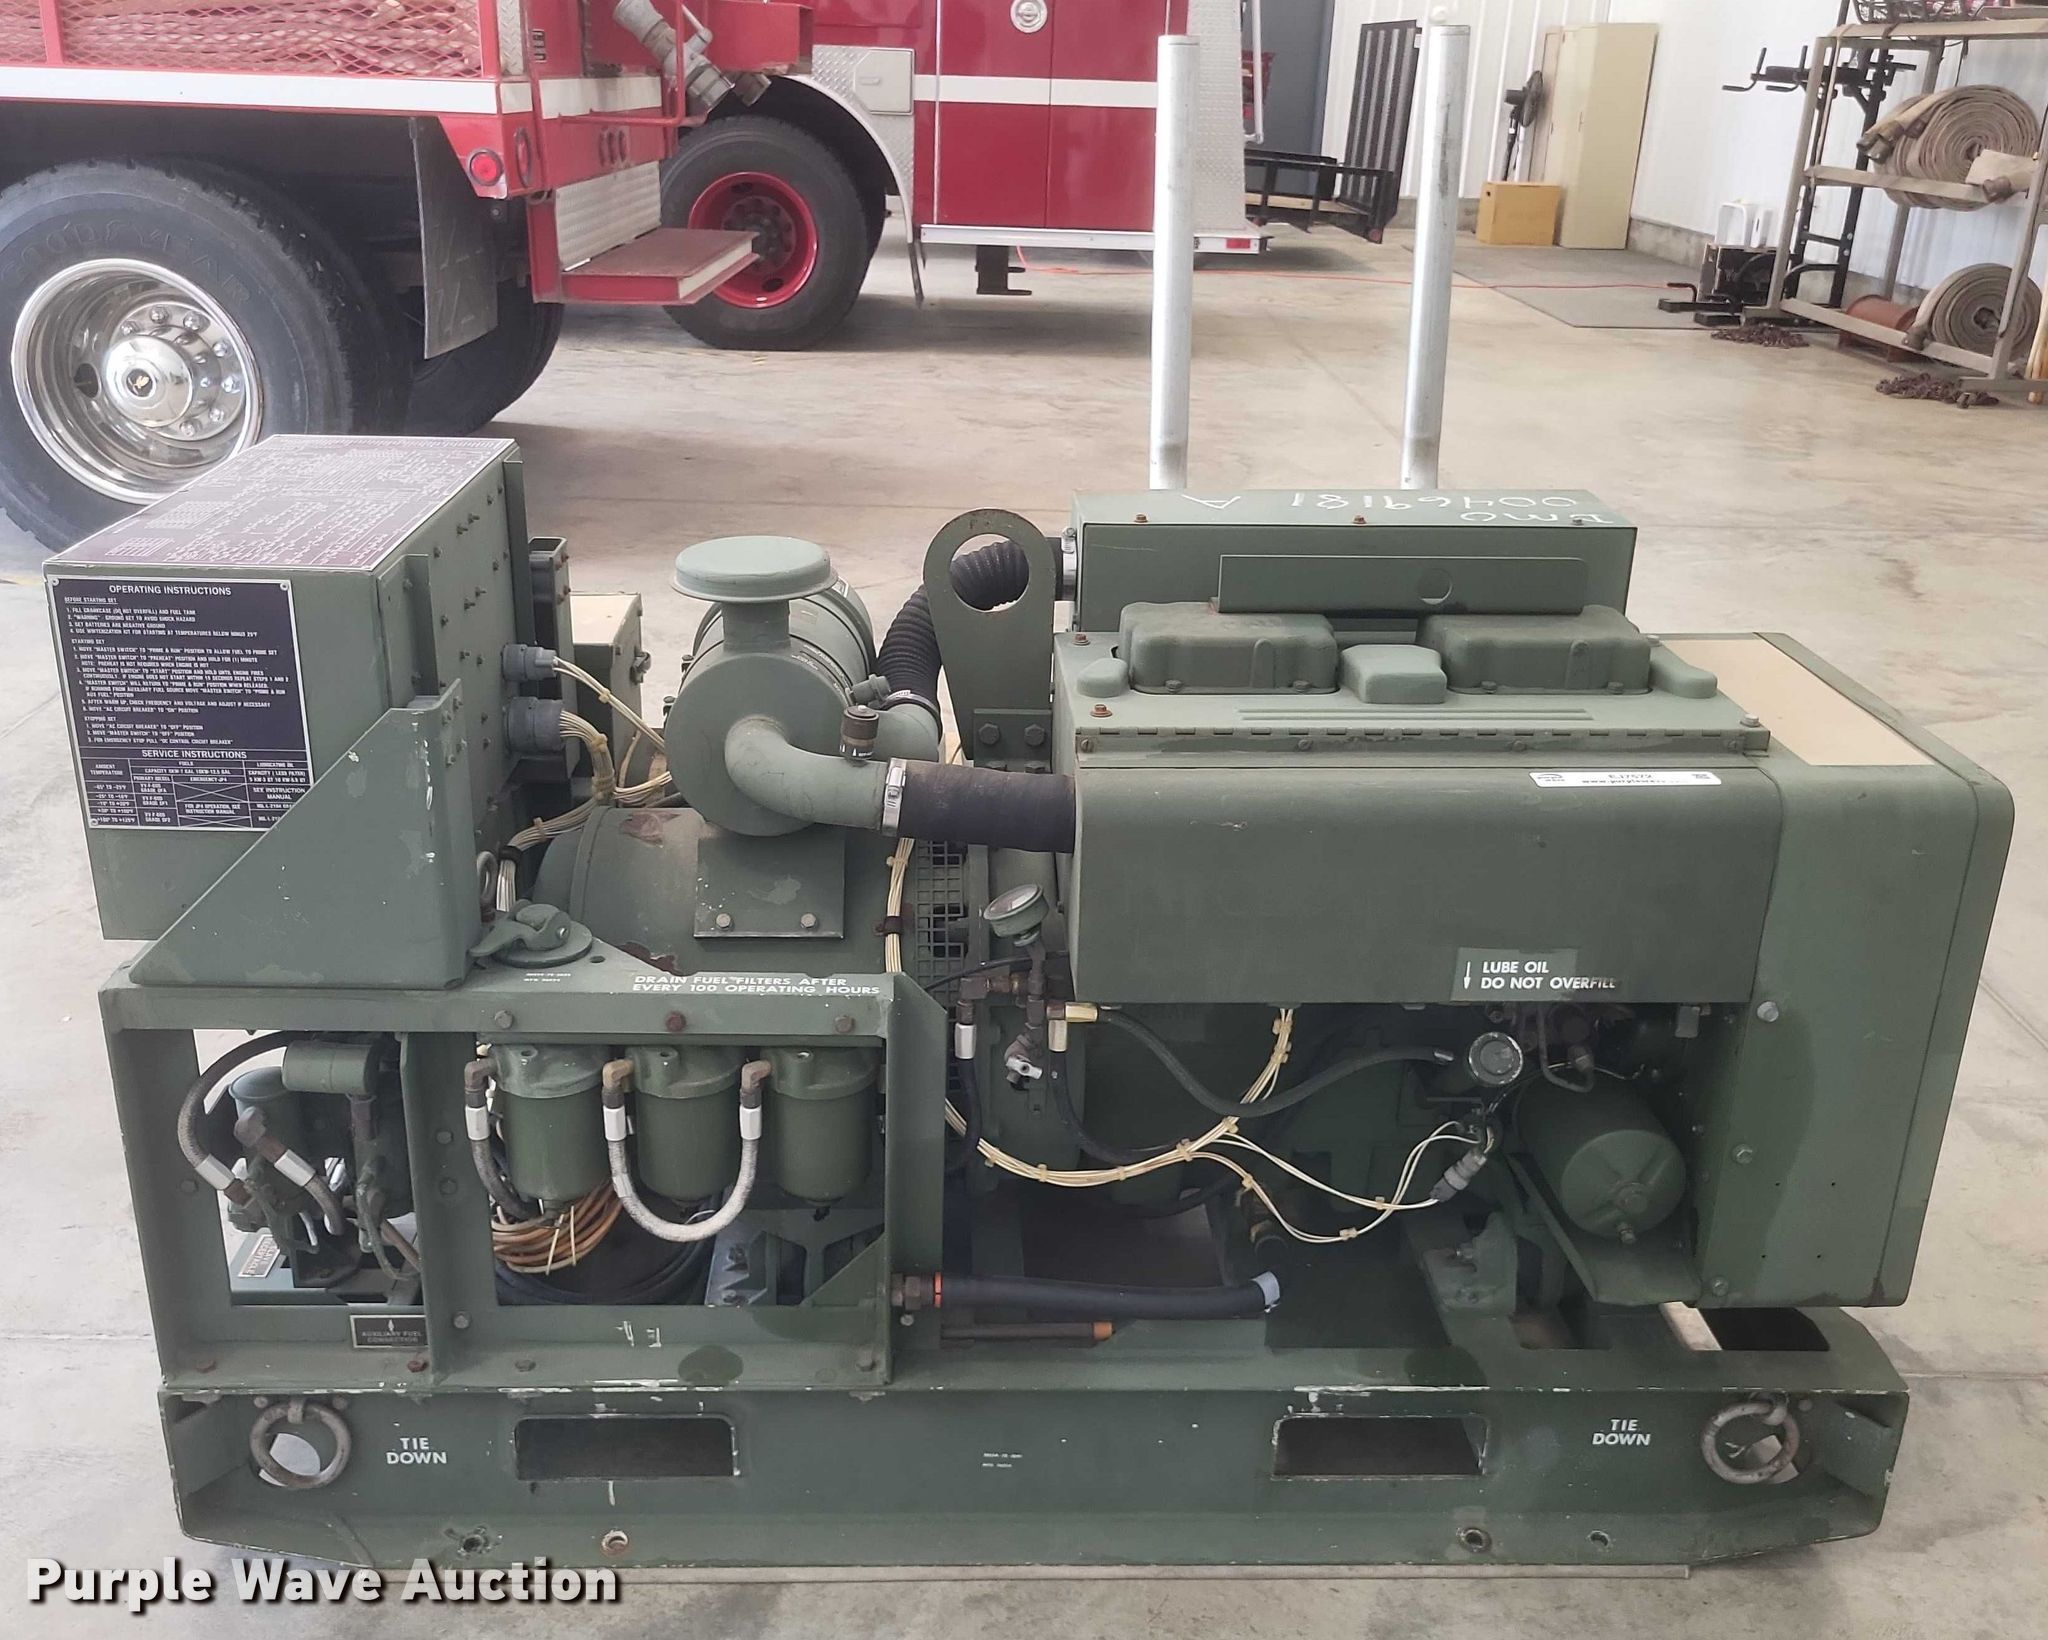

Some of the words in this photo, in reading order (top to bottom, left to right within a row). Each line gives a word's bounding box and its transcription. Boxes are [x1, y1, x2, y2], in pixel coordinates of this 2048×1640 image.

[1181, 494, 1241, 509] A
[164, 586, 232, 595] INSTRUCTIONS
[182, 751, 248, 759] INSTRUCTIONS
[1482, 961, 1519, 974] LUBE
[1523, 961, 1549, 974] OIL
[635, 976, 688, 984] DRAIN
[693, 976, 728, 985] FUEL
[734, 977, 791, 986] FILTERS
[798, 977, 848, 986] AFTER
[1480, 976, 1505, 990] DO
[1509, 976, 1544, 990] NOT
[1549, 976, 1616, 990] OVERFILL
[632, 984, 680, 992] EVERY
[690, 984, 718, 992] 100
[724, 985, 817, 993] OPERATING
[825, 985, 880, 994] HOURS
[1610, 1419, 1639, 1431] TIE
[399, 1437, 430, 1450] TIE
[1592, 1433, 1652, 1446] DOWN
[386, 1451, 447, 1465] DOWN
